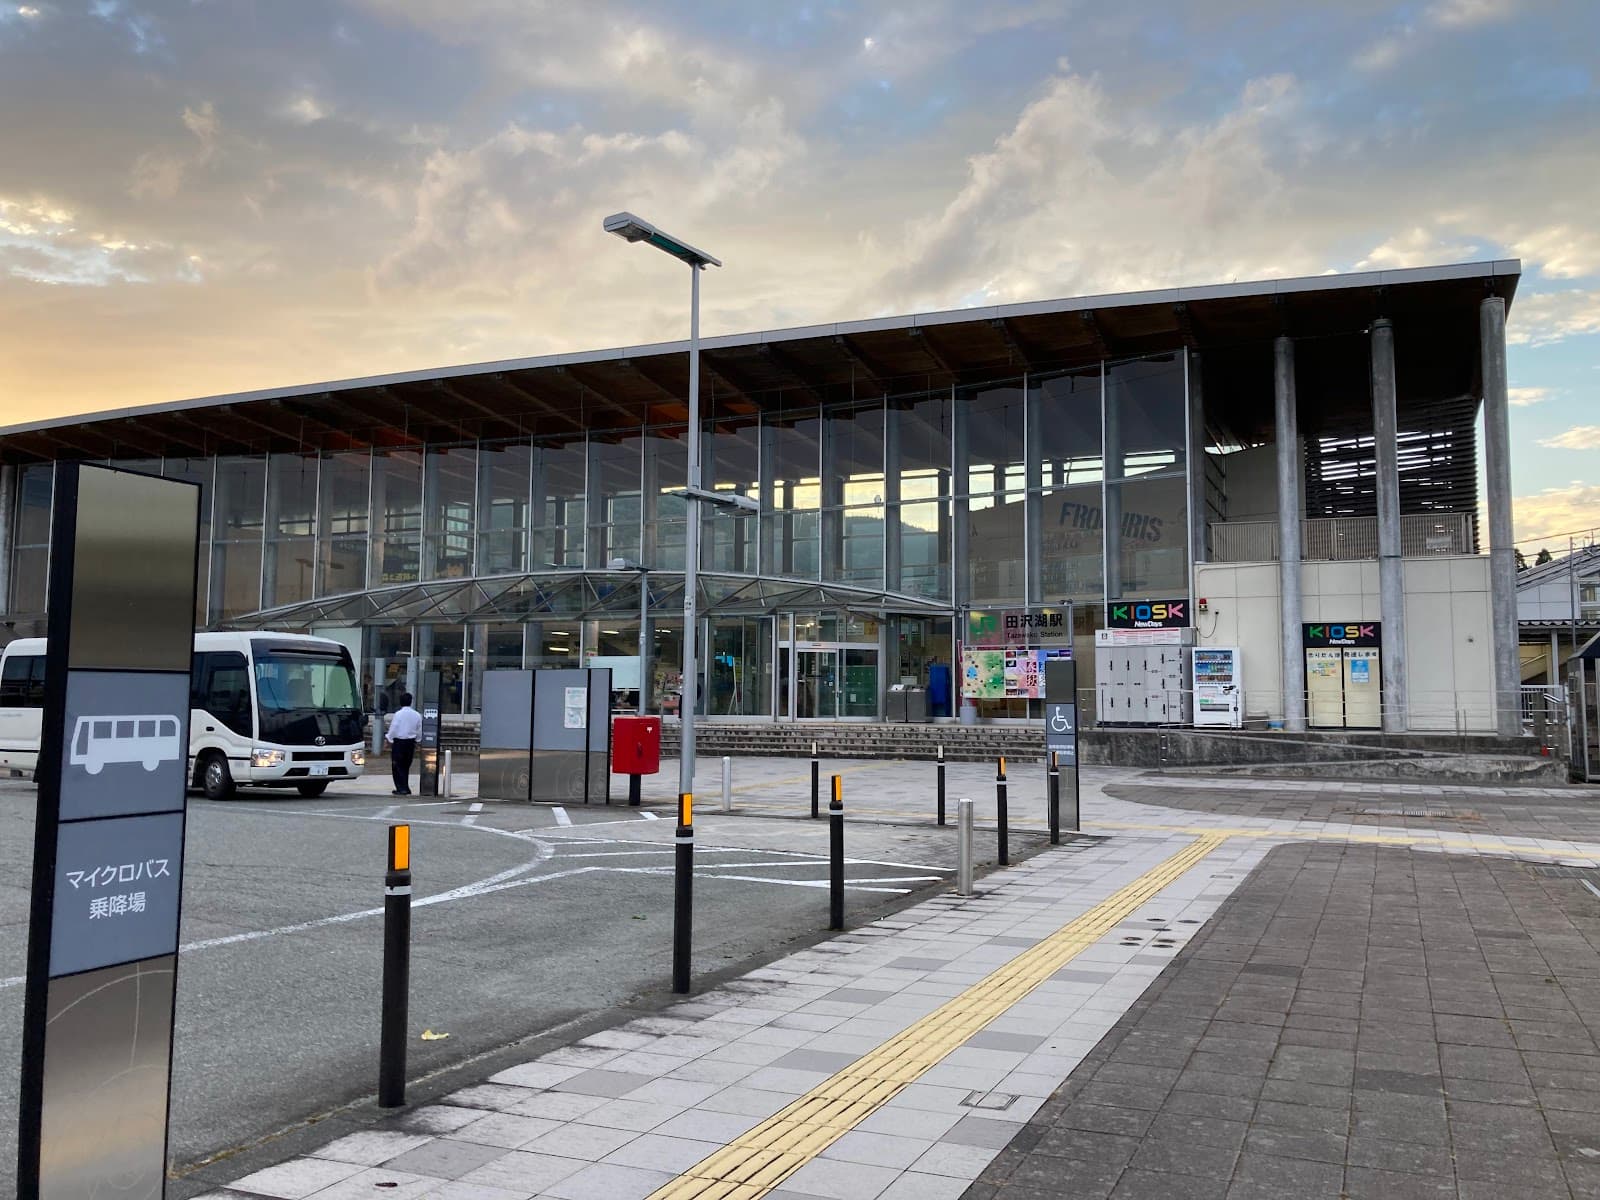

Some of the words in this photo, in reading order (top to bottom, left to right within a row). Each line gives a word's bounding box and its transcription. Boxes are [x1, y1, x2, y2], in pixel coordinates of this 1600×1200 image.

[1113, 603, 1184, 620] KIOSK
[1006, 613, 1063, 629] 田沢湖駅
[1134, 620, 1163, 628] NewDays
[1309, 625, 1375, 639] KIOSK
[66, 858, 171, 889] マイクロバス
[89, 891, 147, 920] 乗降場
